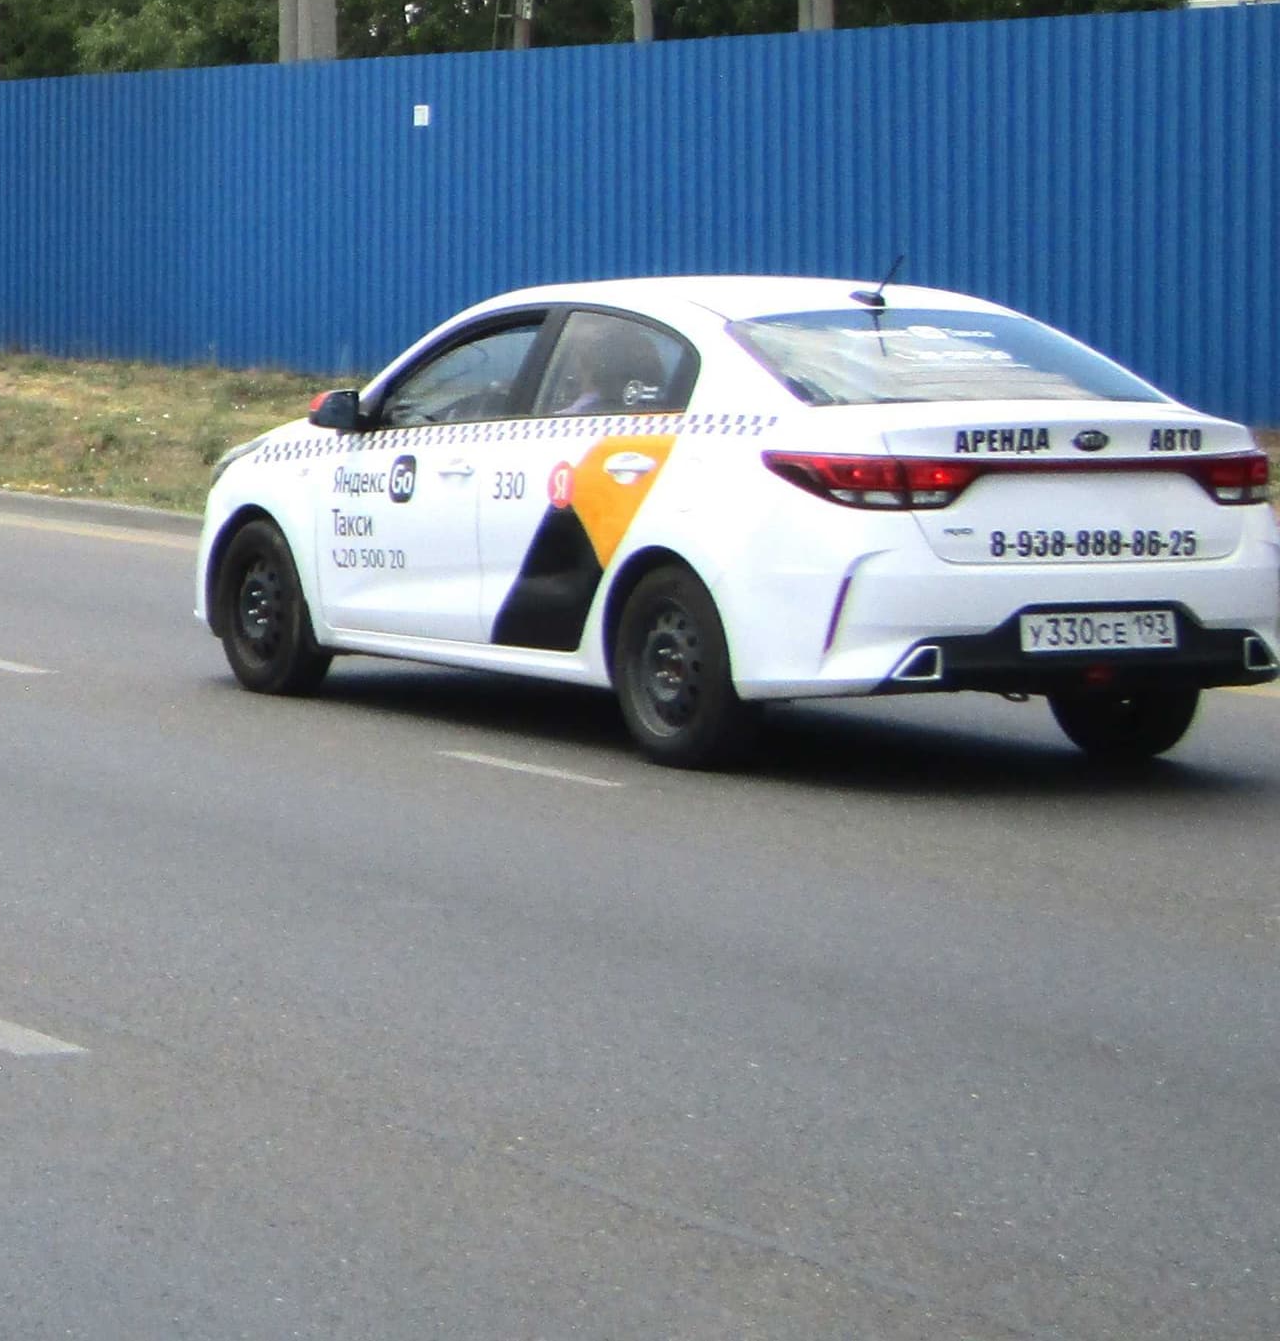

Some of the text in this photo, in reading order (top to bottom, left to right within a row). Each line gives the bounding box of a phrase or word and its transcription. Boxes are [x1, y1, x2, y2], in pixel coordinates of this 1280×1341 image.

[955, 428, 1050, 454] АРЕНДА
[1149, 428, 1203, 451] АВТО
[333, 466, 413, 497] Яндекс Go
[493, 471, 525, 500] 330
[331, 509, 373, 537] Такси
[991, 529, 1197, 557] 8-938-888-86-25
[361, 549, 385, 568] 500
[390, 550, 405, 569] 20
